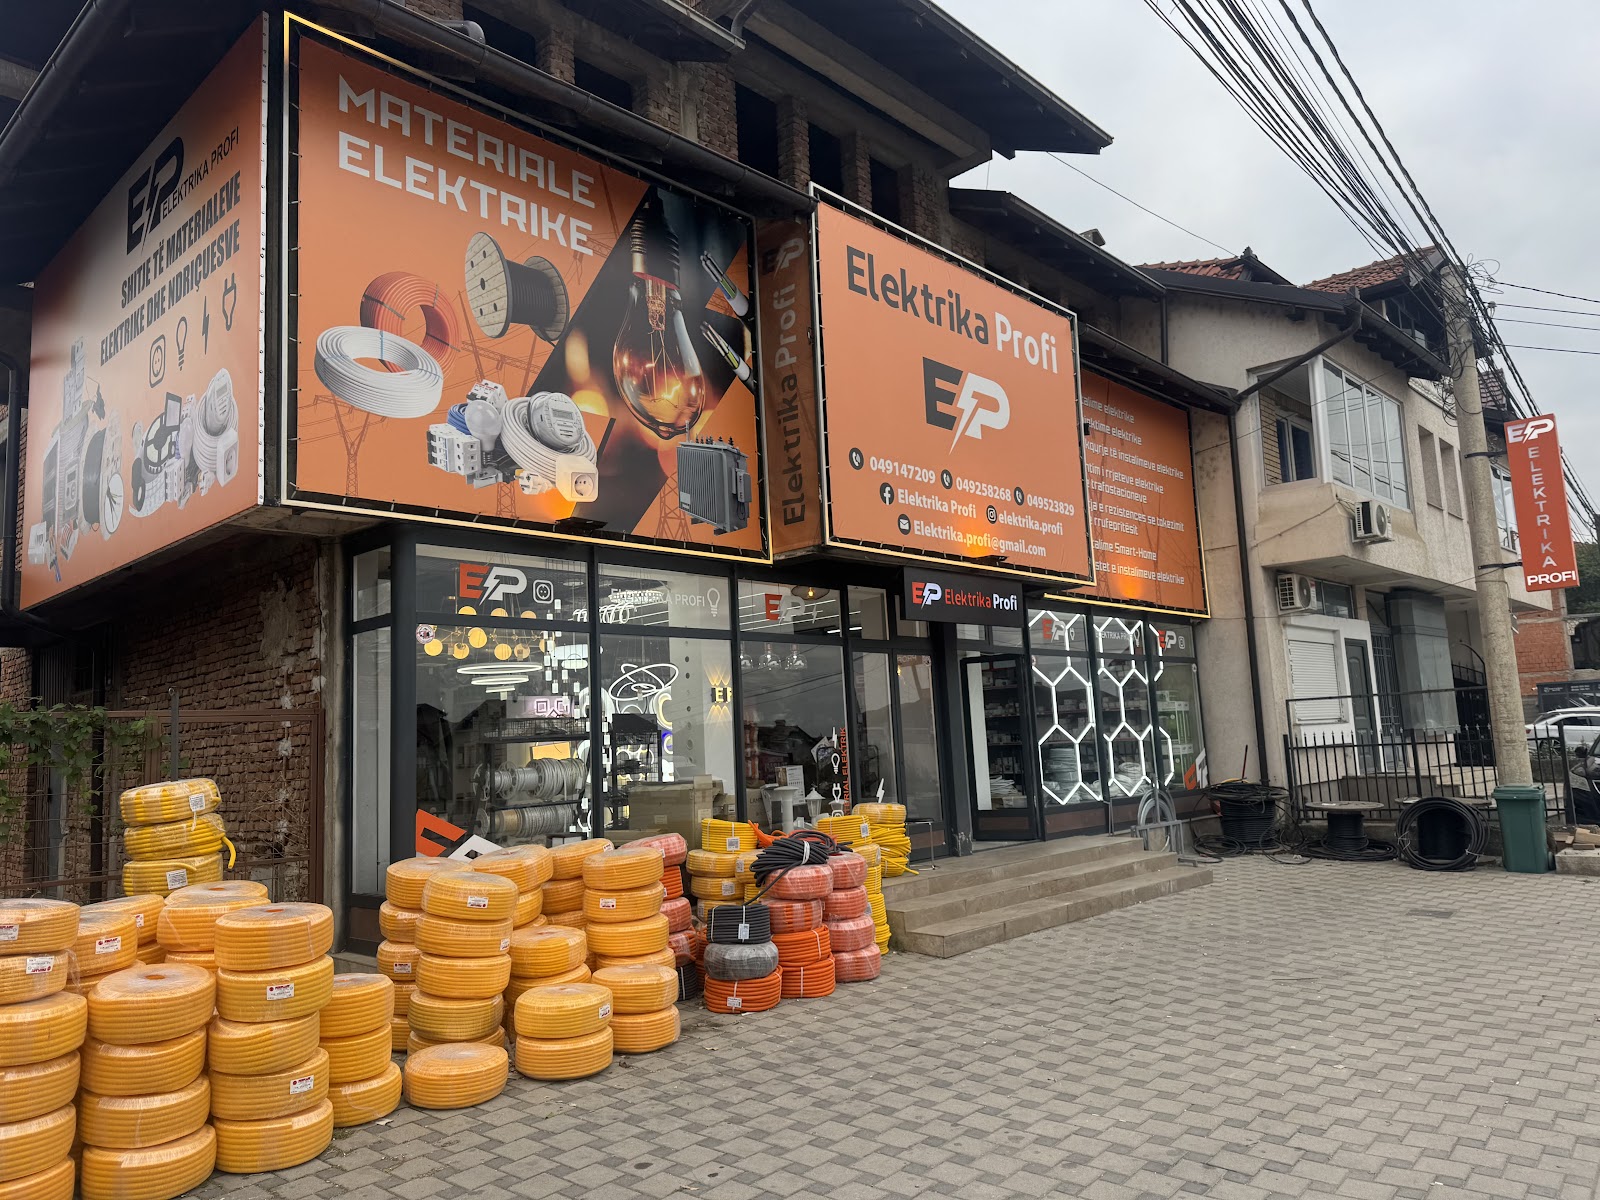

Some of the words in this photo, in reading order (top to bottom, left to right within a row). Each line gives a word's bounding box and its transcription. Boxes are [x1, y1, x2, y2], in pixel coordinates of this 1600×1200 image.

[338, 74, 595, 208] MATERIALE
[162, 160, 209, 219] ELEKTRIKA
[210, 126, 239, 171] PROFI
[338, 130, 594, 256] ELEKTRIKE
[121, 257, 151, 309] SHITJE
[153, 239, 165, 278] TË
[166, 170, 241, 270] MATERIALEVE
[100, 305, 145, 367] ELEKTRIKE
[147, 286, 166, 328] DHE
[168, 219, 240, 310] NDRIÇUESVE
[846, 245, 989, 345] Elektrika
[995, 311, 1058, 374] Profi
[773, 282, 797, 371] Profi
[776, 373, 806, 526] Elektrika
[1111, 427, 1142, 446] elektrike
[869, 456, 936, 484] 049147209
[956, 477, 1012, 502] 049258268
[1026, 493, 1075, 517] 049523829
[1118, 449, 1156, 471] instalimeve
[1157, 463, 1184, 480] elektrike
[1135, 478, 1164, 494] elektrike
[897, 488, 949, 513] Elektrika
[950, 500, 977, 519] Profi
[998, 511, 1064, 537] elektrika.profi
[1528, 446, 1558, 568] ELEKTRIKA
[913, 520, 1047, 557] Elektrika.profi@gmail.com
[1115, 542, 1157, 561] Smart-Home
[675, 593, 705, 607] PROFI
[944, 588, 992, 609] Elektrika
[992, 593, 1018, 611] Profi
[1117, 562, 1156, 580] instalimeve
[1157, 572, 1185, 585] elektrike
[1526, 570, 1577, 586] PROFI
